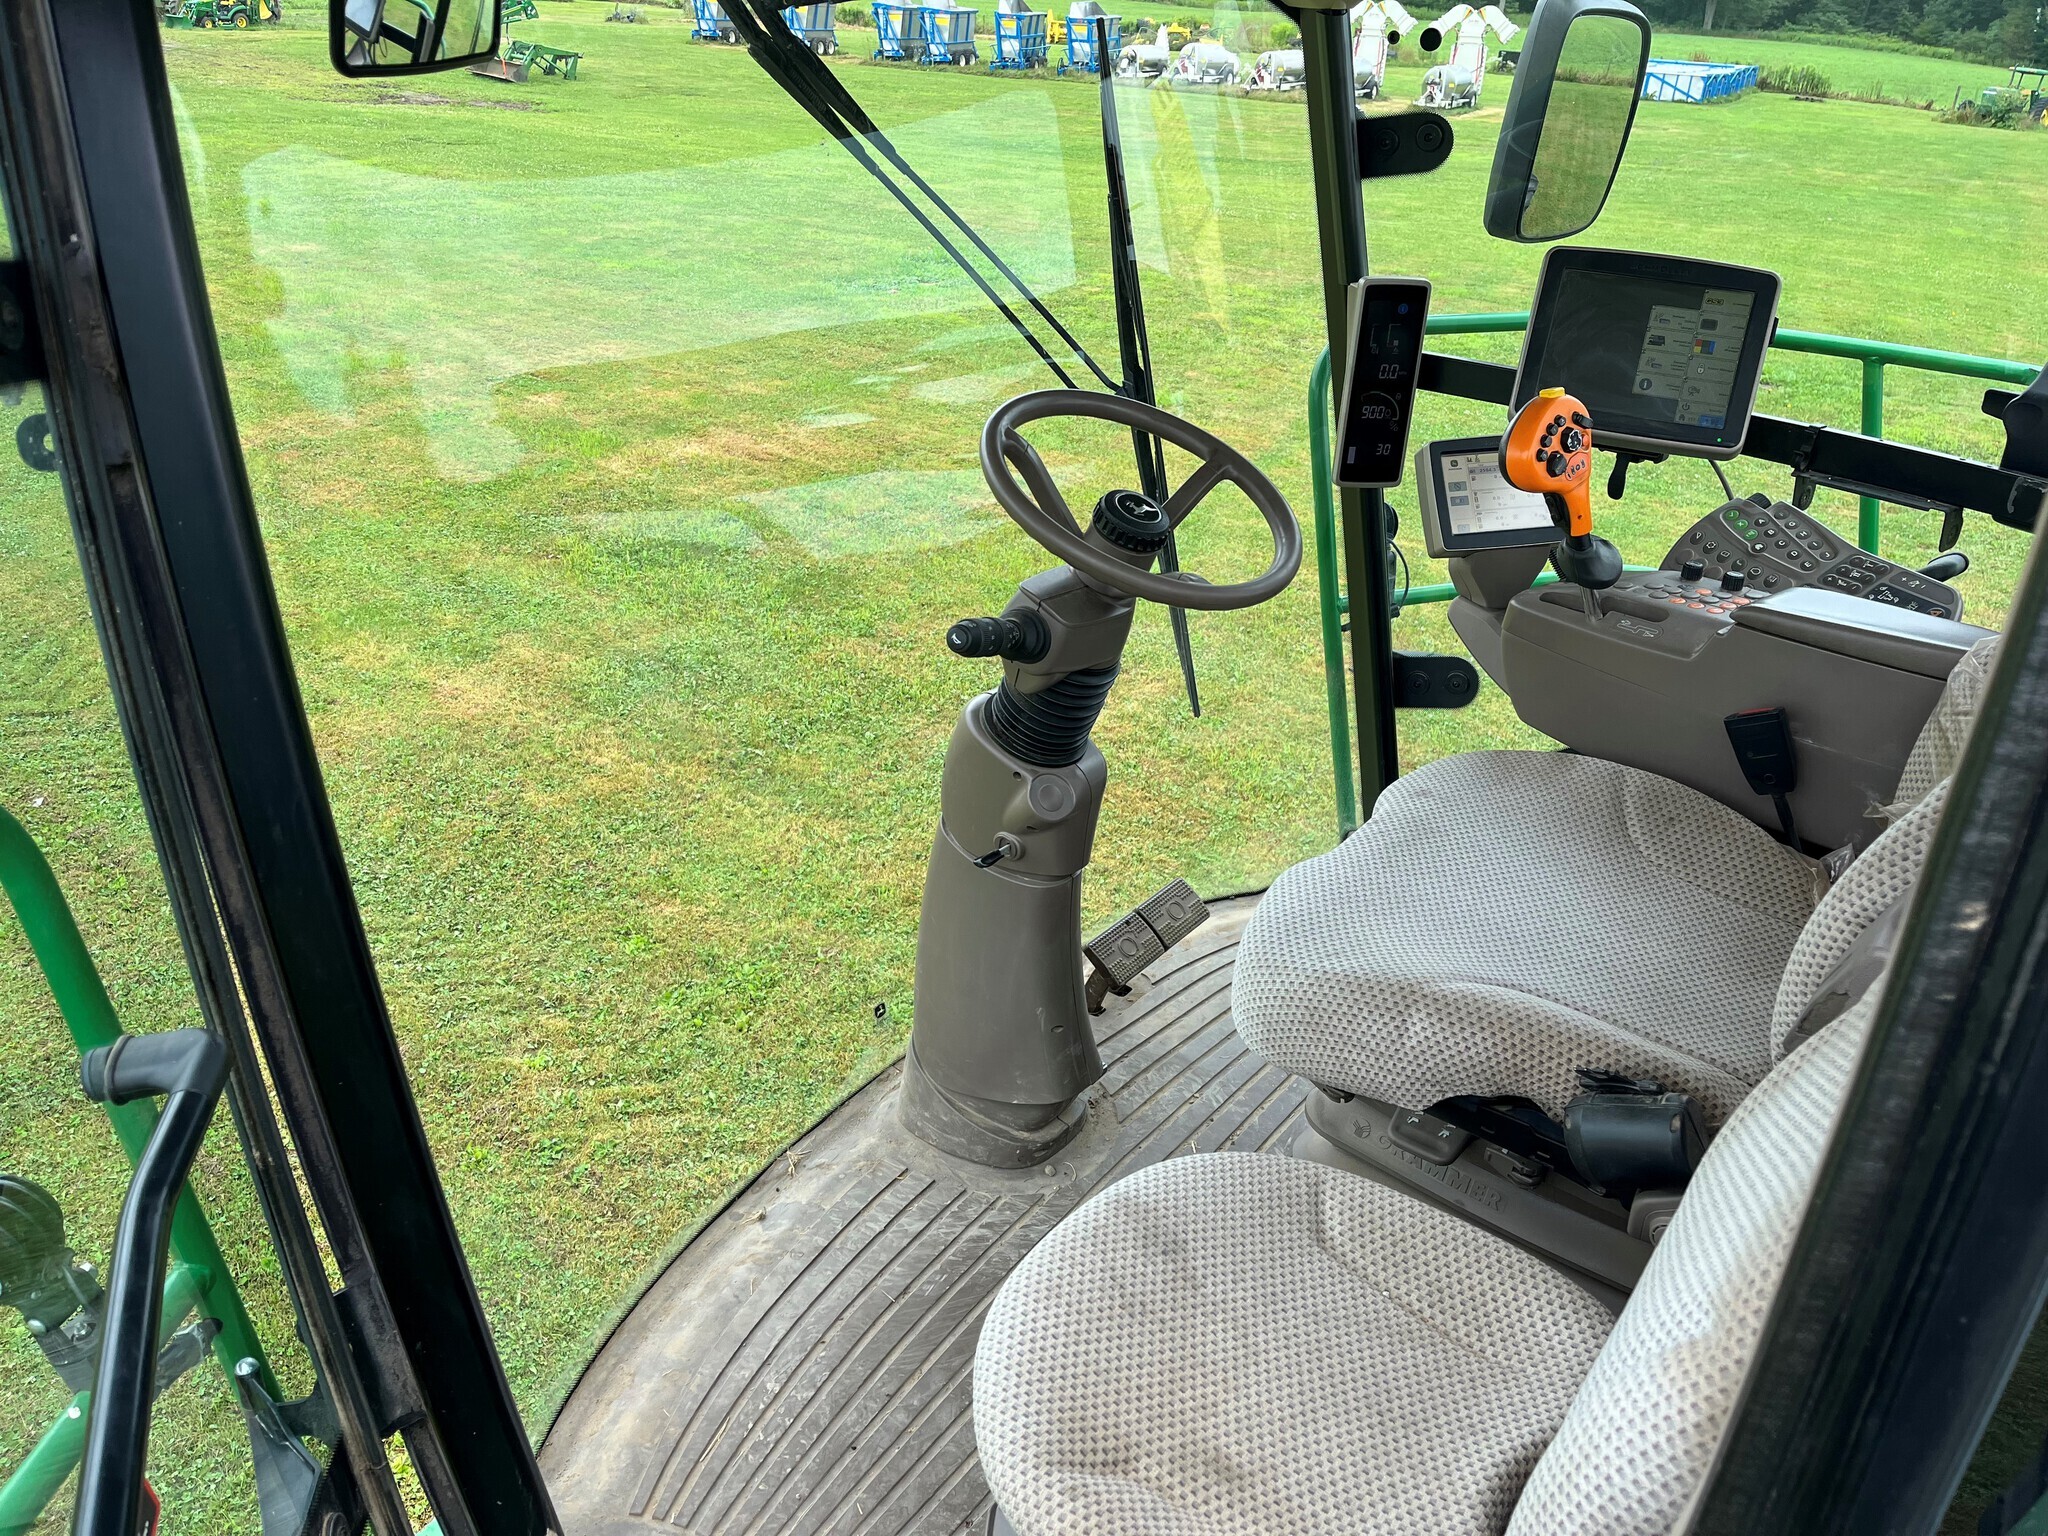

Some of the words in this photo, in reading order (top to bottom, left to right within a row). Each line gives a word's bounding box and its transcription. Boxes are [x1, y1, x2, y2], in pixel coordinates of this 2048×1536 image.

[1379, 364, 1399, 379] 0.0
[1361, 405, 1386, 419] 900
[1375, 444, 1391, 455] 30
